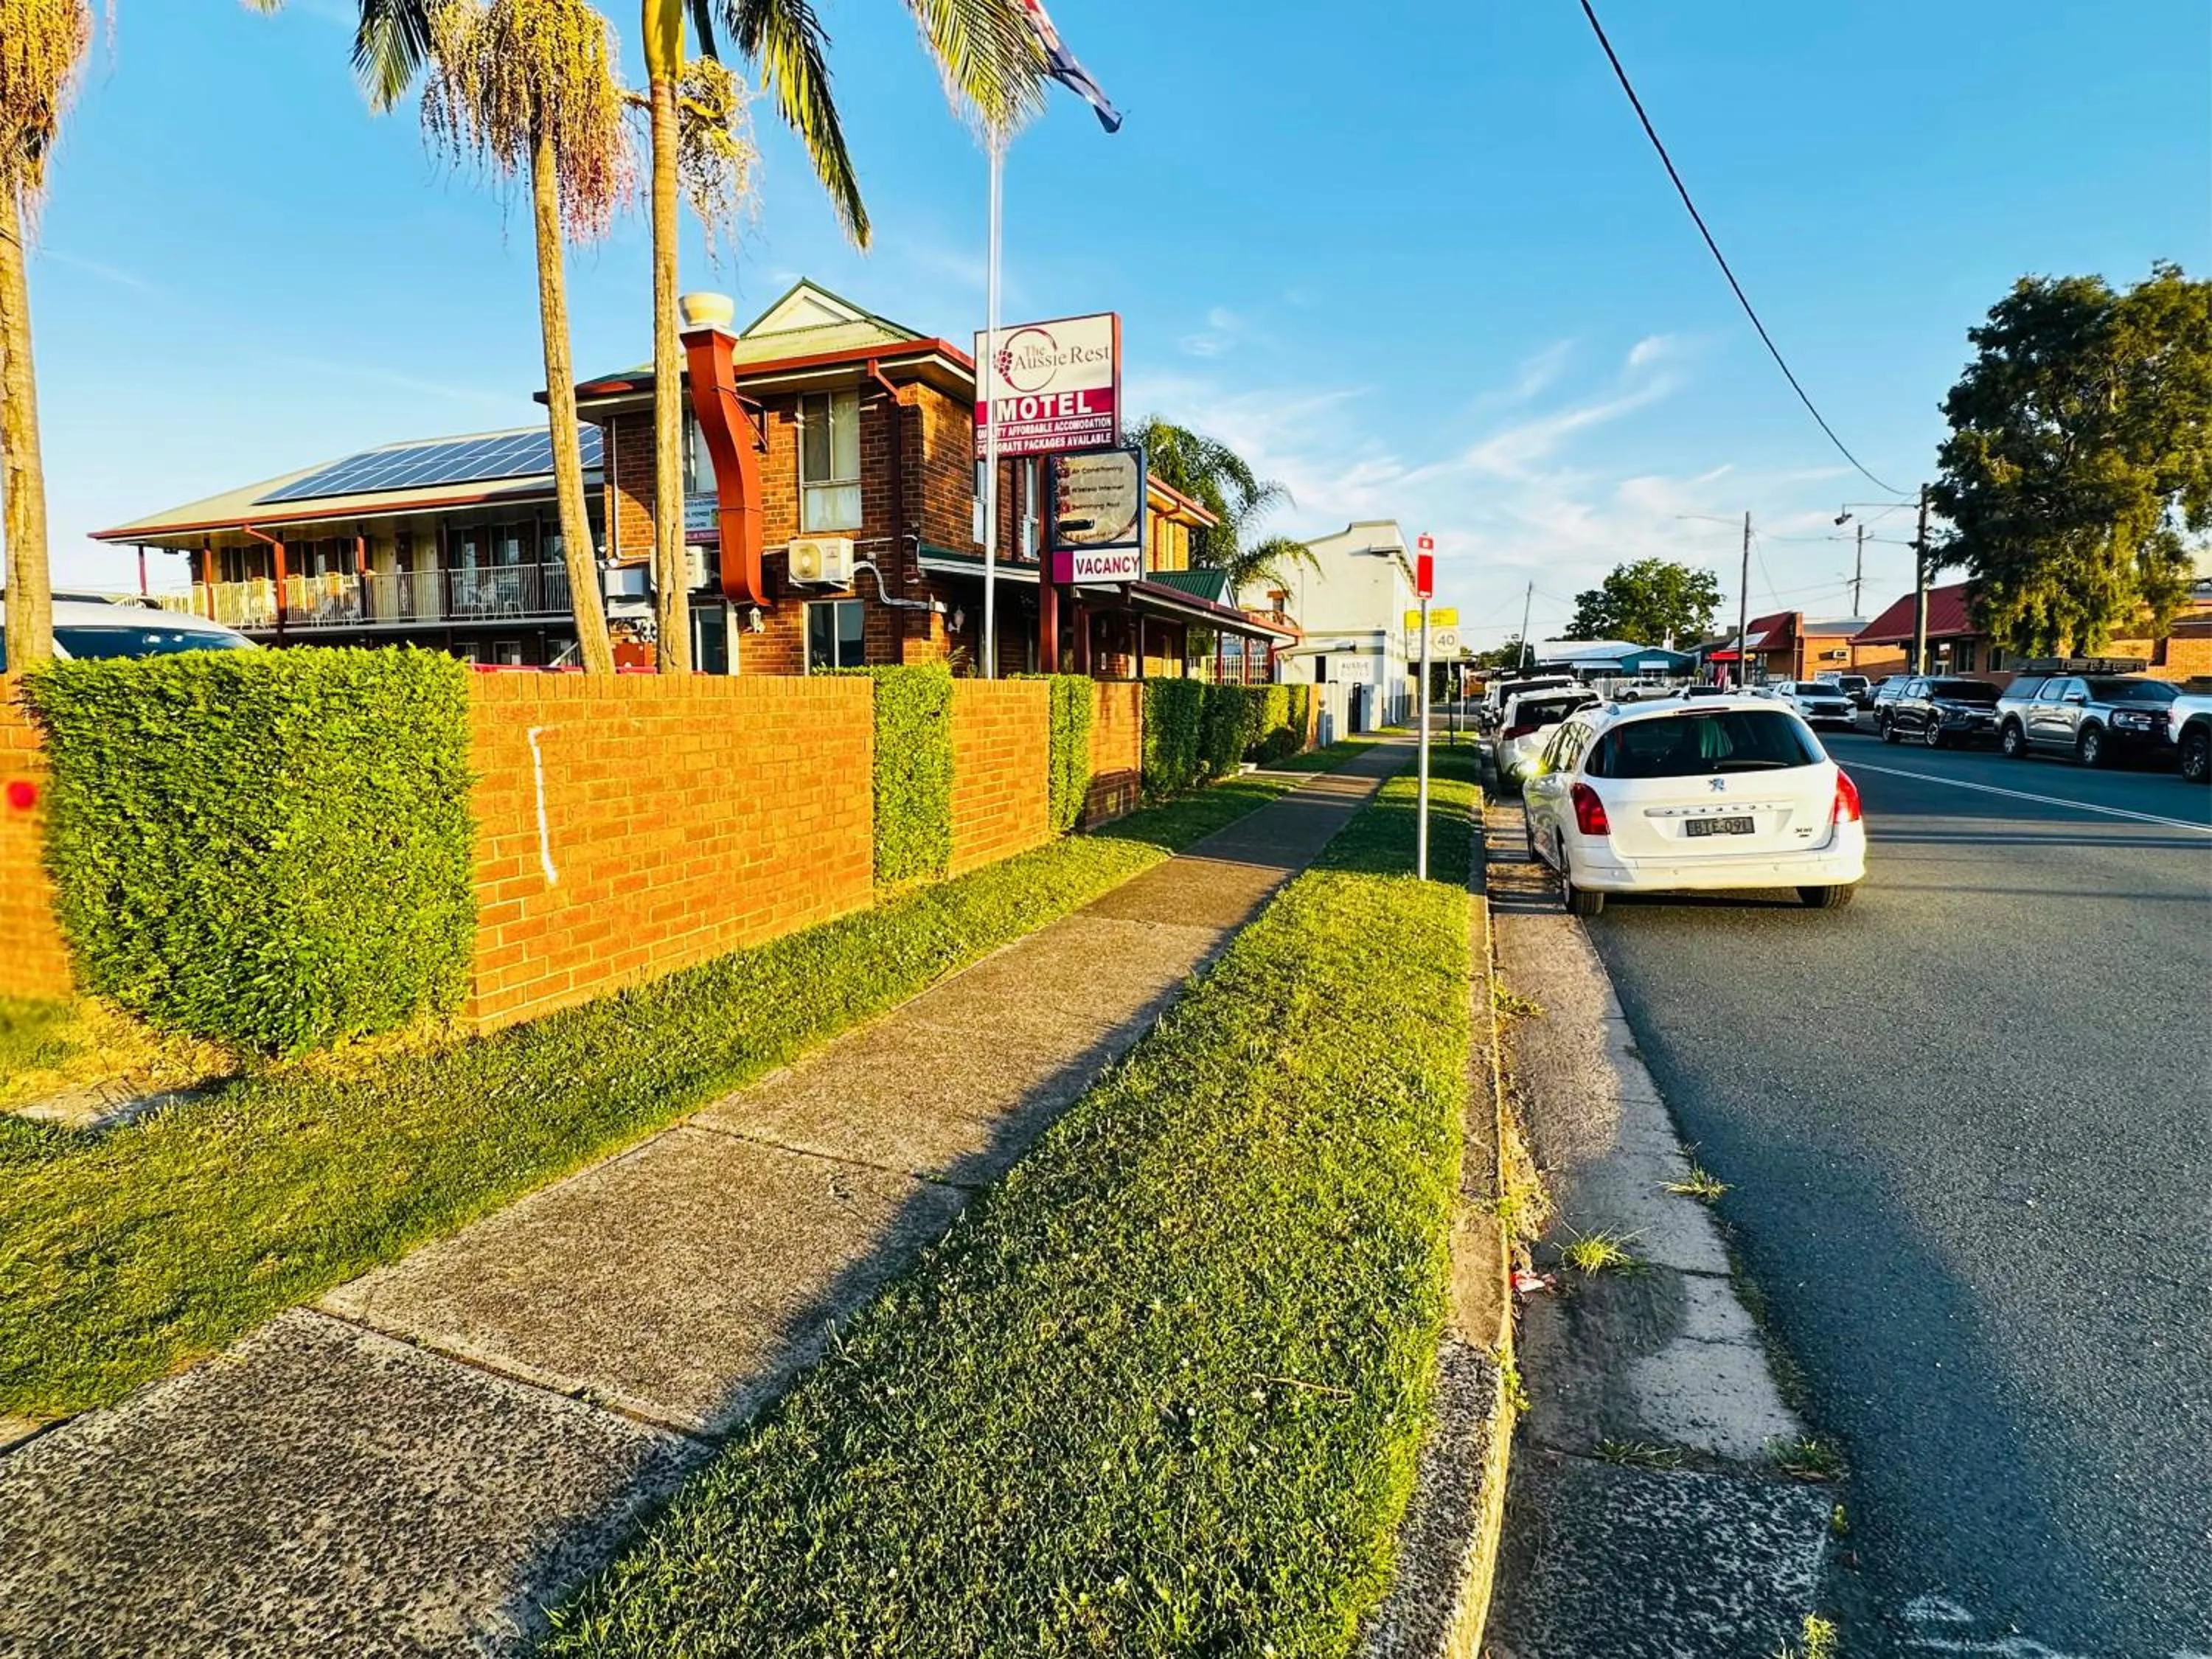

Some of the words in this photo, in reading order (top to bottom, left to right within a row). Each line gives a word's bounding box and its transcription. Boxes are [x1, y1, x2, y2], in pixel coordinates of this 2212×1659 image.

[1013, 353, 1067, 371] Aussie
[1071, 346, 1109, 364] Rest
[996, 392, 1092, 422] MOTEL
[1024, 437, 1065, 452] PACKAGES
[1067, 432, 1111, 447] AVAILABLE
[1076, 555, 1139, 575] VACANCY
[1438, 633, 1455, 647] 40
